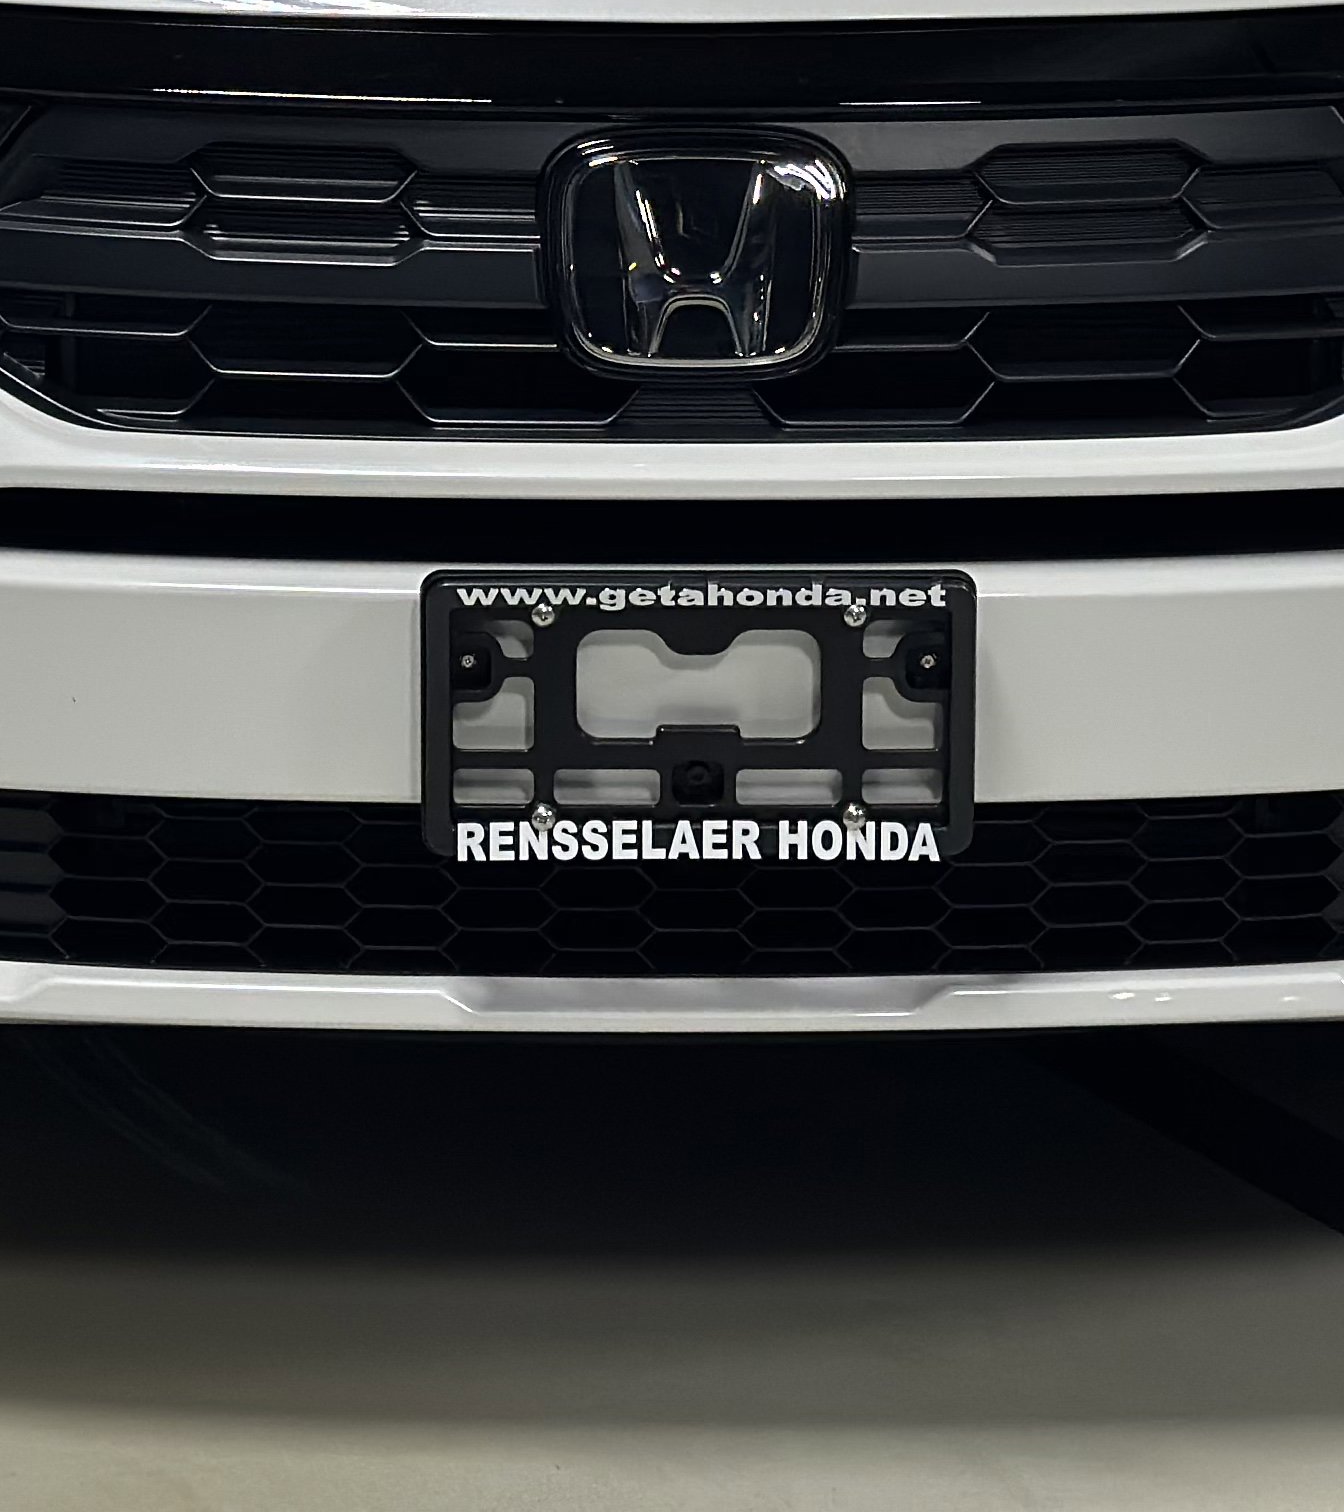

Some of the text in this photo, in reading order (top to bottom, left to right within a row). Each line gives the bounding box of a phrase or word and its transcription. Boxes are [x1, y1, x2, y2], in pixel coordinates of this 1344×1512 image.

[456, 582, 947, 612] www.getahonda.net
[456, 819, 941, 863] RENSSELAER HONDA
